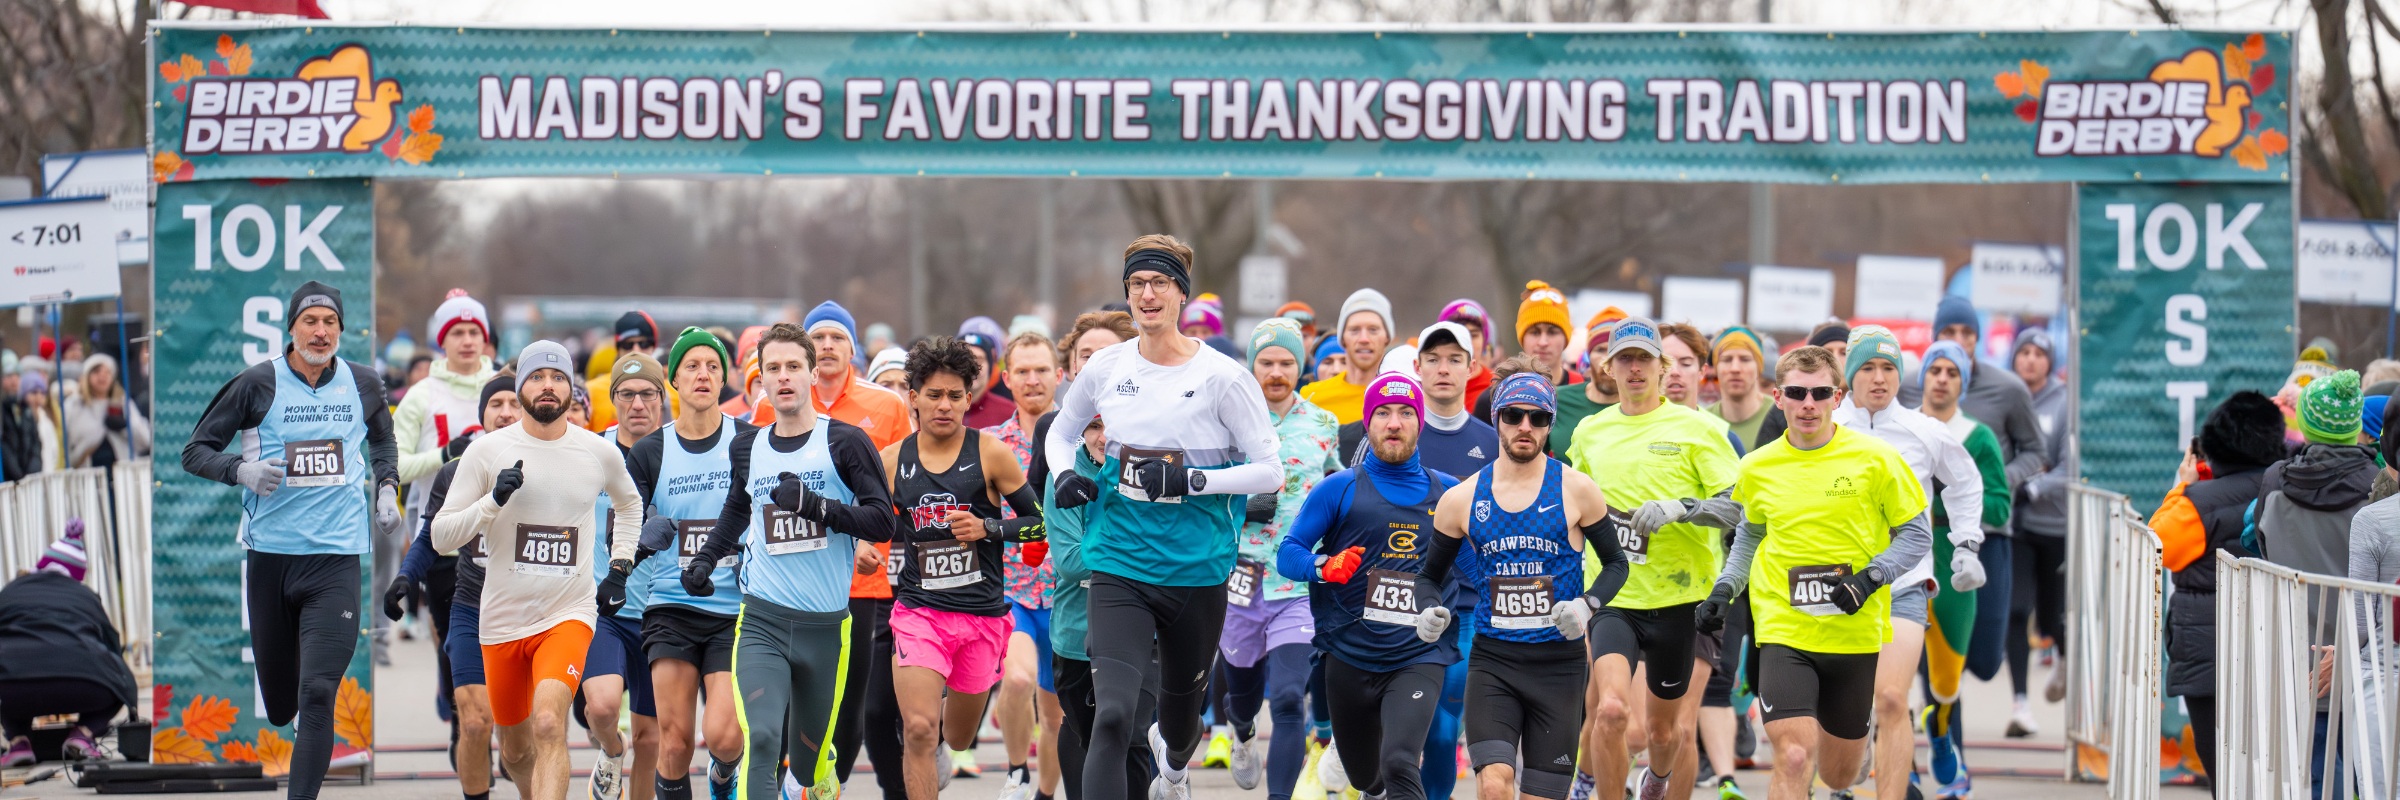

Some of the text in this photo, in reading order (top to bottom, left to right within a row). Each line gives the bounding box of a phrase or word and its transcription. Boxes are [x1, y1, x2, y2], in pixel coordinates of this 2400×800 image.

[190, 78, 359, 117] BIRDIE
[480, 70, 1967, 143] MADISON'S FAVORITE THANKSGIVING TRADITION
[2044, 81, 2208, 119] BIRDIE
[184, 116, 357, 153] DERBY
[2037, 118, 2208, 155] DERBY
[33, 222, 82, 247] 7:01
[182, 203, 346, 272] 10K
[2105, 202, 2268, 272] 10K
[1615, 325, 1654, 341] CHAMPIONS
[1117, 385, 1140, 394] ASCENT
[283, 414, 353, 423] RUNNING CLUB
[284, 405, 352, 414] MOVIN' SHOES
[293, 453, 338, 475] 4150
[796, 470, 824, 480] HOES
[668, 470, 731, 486] MOVIN' SHO
[668, 480, 730, 496] RUNNING CL
[807, 480, 825, 491] LUB
[1825, 489, 1857, 497] Windsor
[773, 516, 818, 540] 4141
[1616, 525, 1642, 551] 05
[522, 539, 571, 564] 4819
[684, 533, 708, 555] 46
[1481, 535, 1559, 557] STRAWBERRY
[887, 555, 905, 574] 57
[925, 550, 973, 577] 4267
[1496, 561, 1544, 575] CANYON
[1228, 571, 1253, 595] 45
[1794, 580, 1835, 604] 409
[1371, 584, 1418, 613] 433
[1495, 591, 1550, 615] 4695
